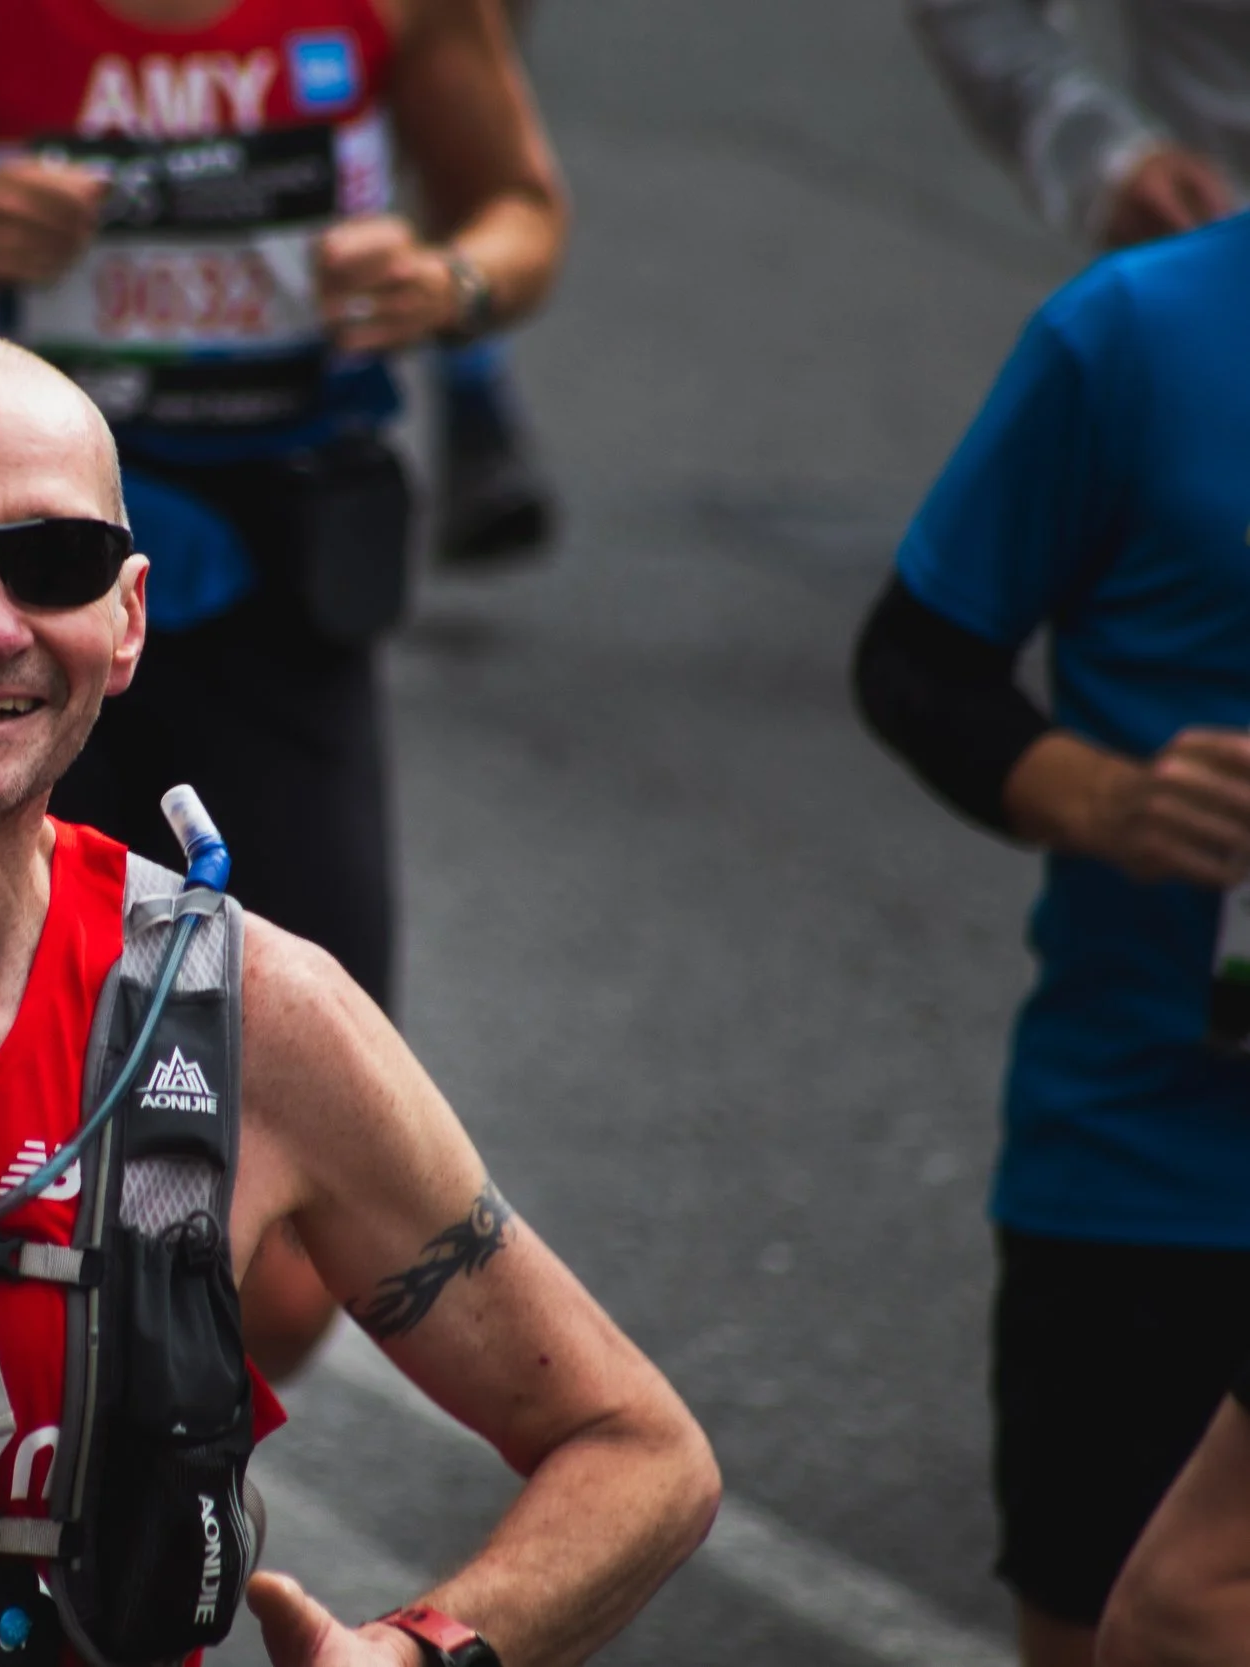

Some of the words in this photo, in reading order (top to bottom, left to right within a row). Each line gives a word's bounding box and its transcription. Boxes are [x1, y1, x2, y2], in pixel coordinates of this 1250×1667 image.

[78, 50, 274, 137] AMY
[141, 1094, 217, 1115] AONIJIE
[194, 1494, 221, 1624] AONIJIE
